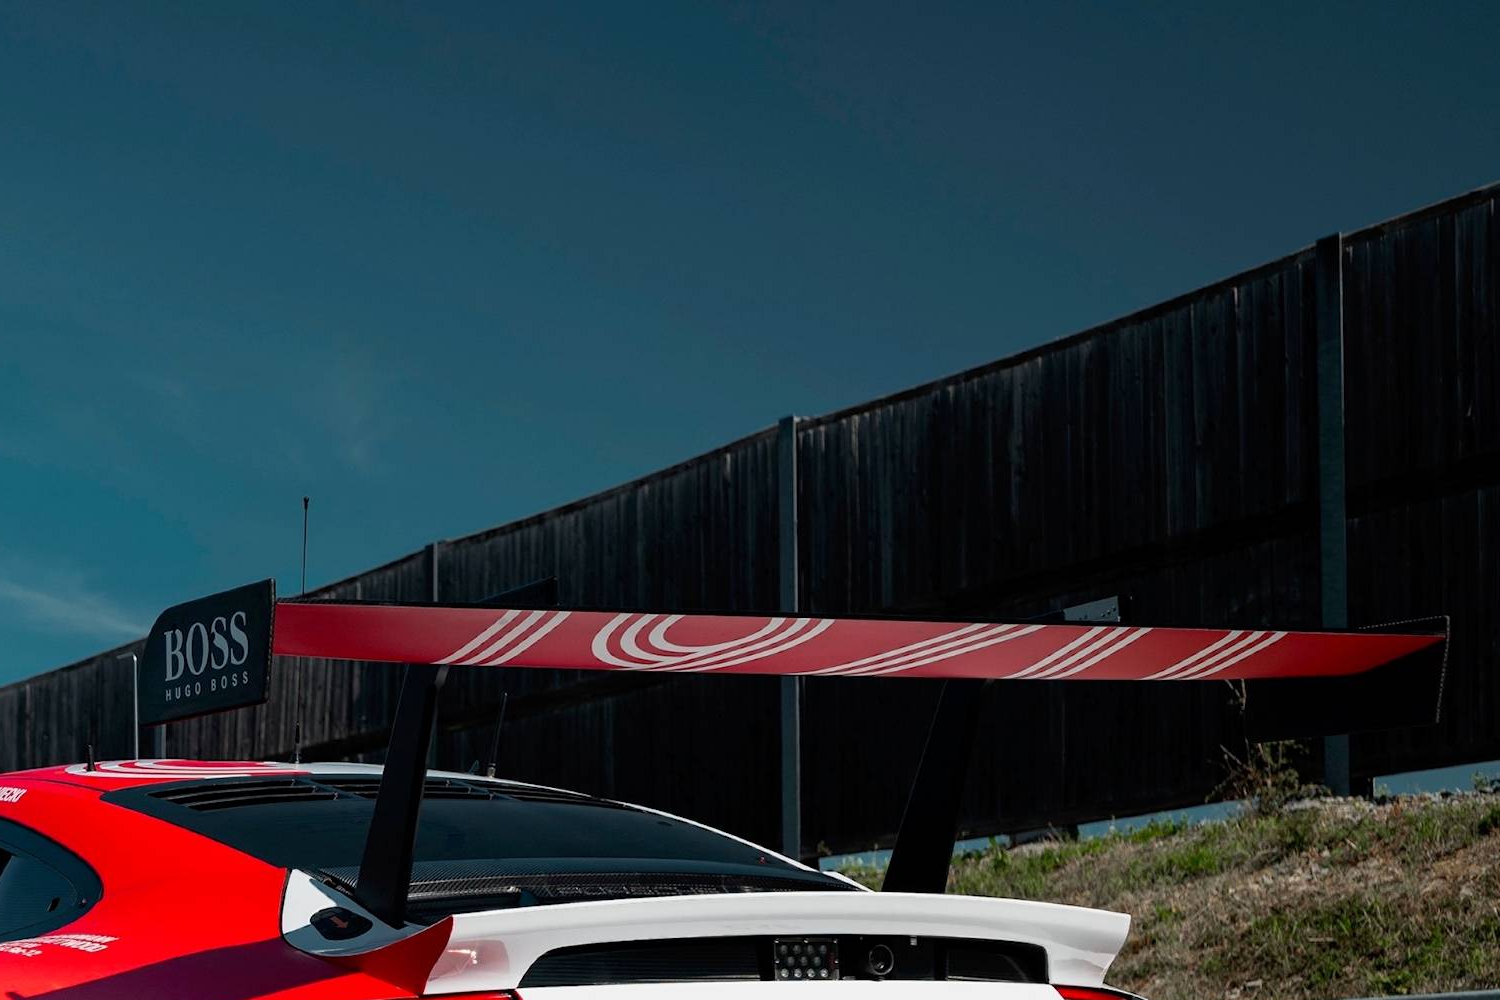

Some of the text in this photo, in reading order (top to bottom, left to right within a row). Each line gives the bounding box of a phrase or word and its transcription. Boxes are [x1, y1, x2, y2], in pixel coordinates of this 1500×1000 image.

[164, 611, 249, 682] BOSS
[165, 671, 249, 701] HUGO BOSS
